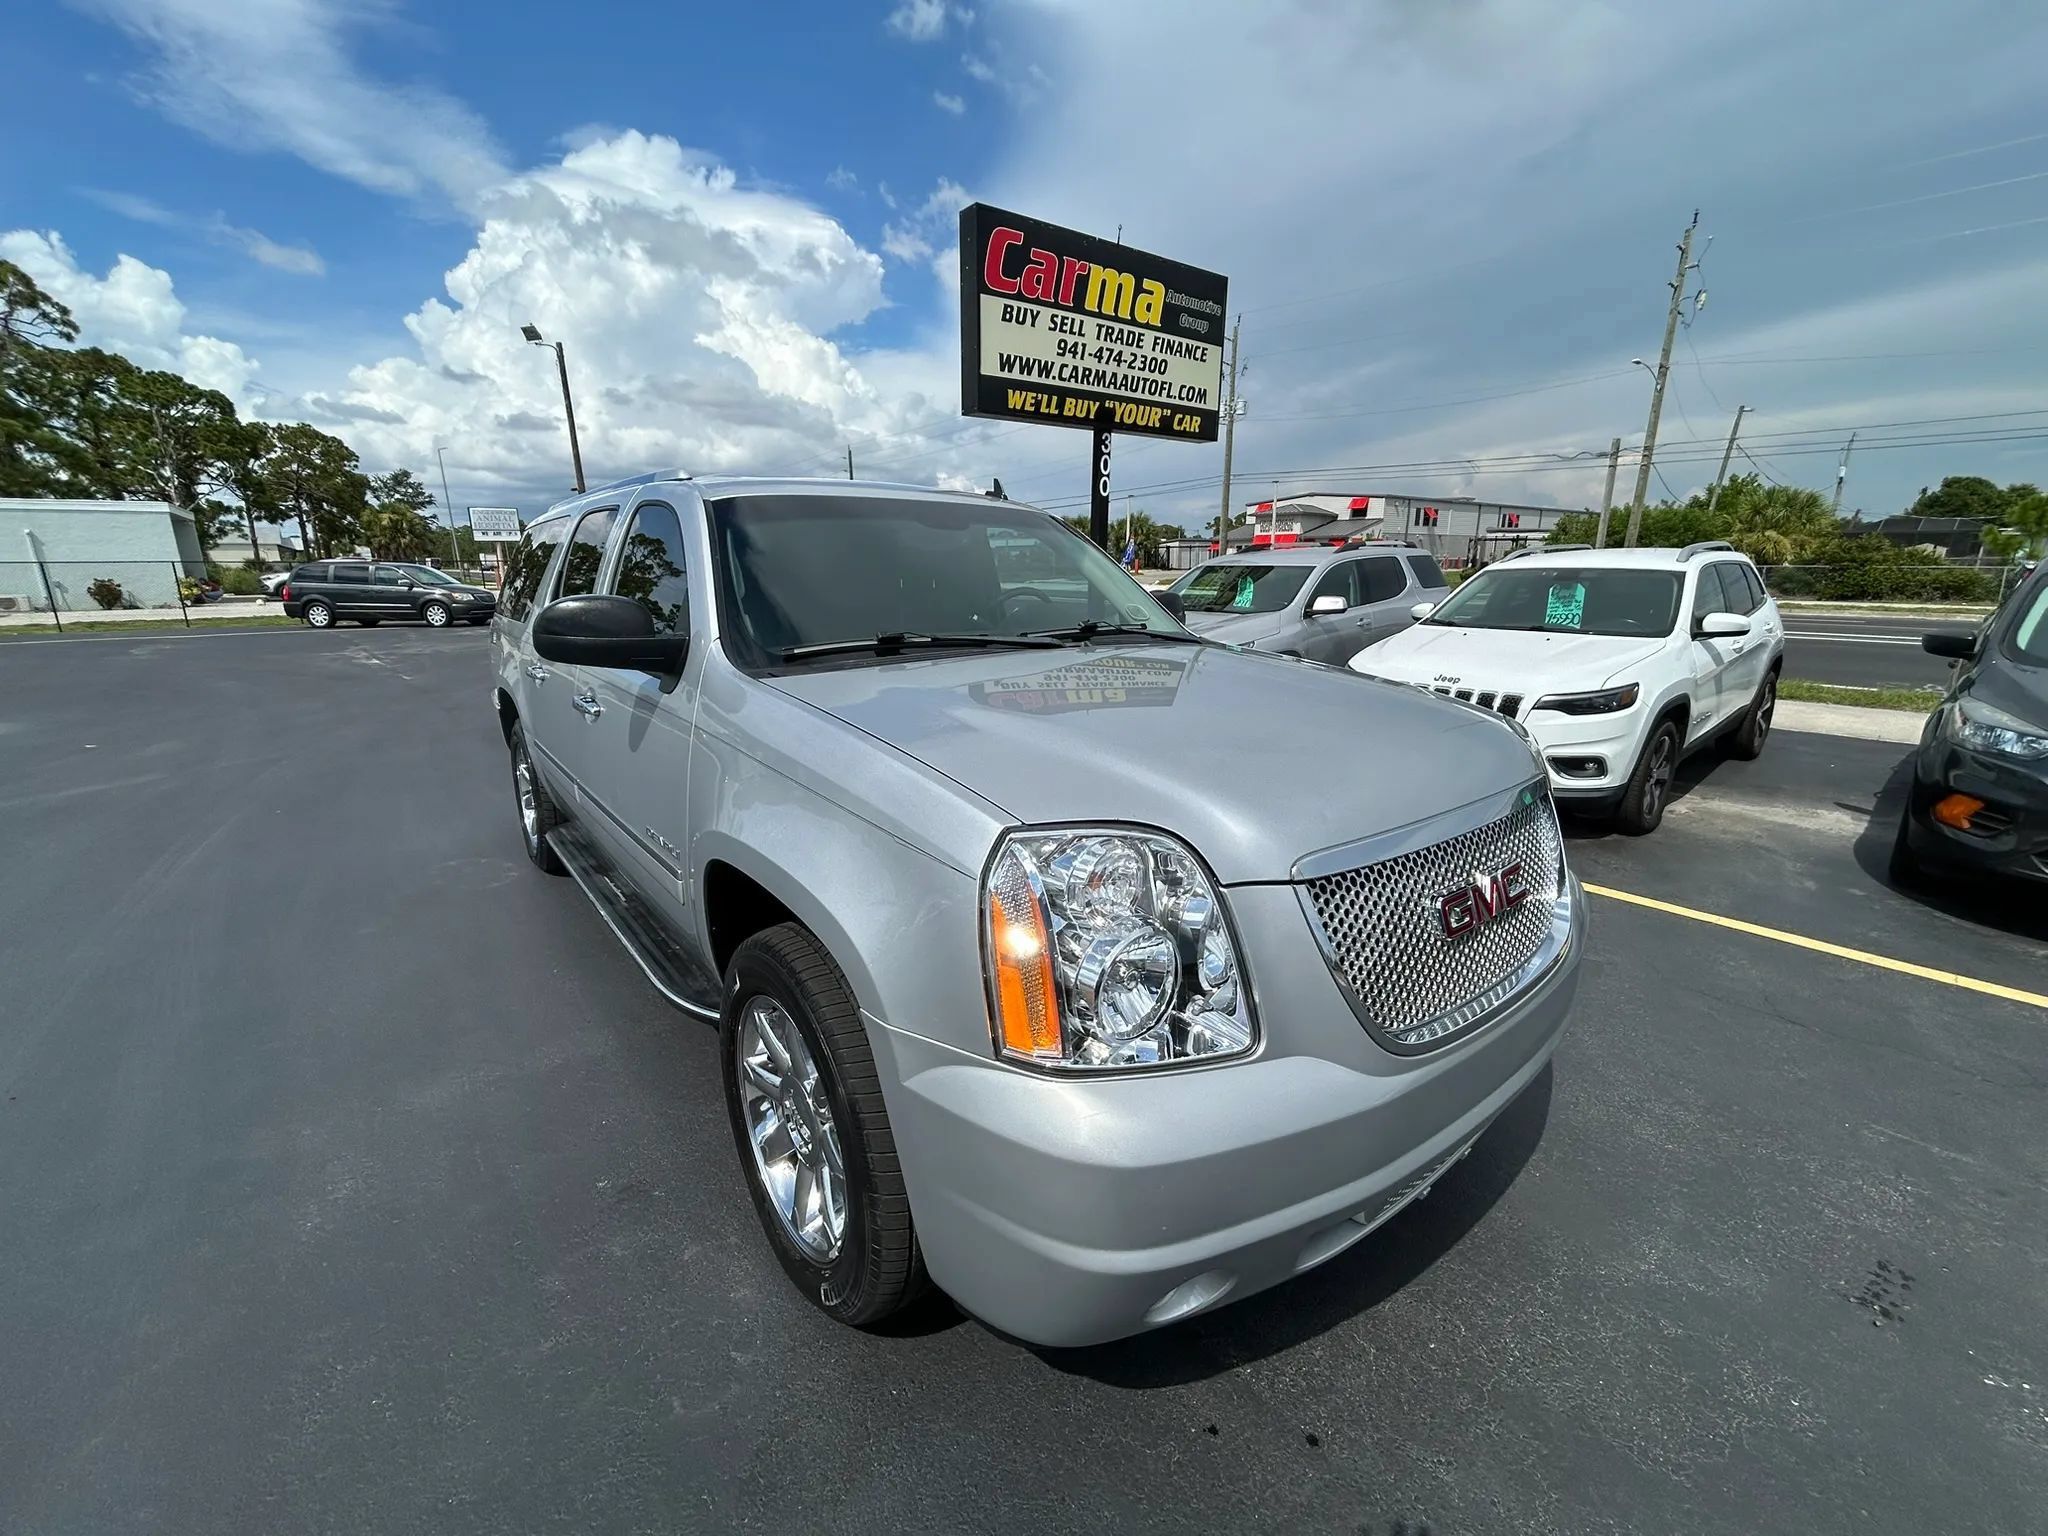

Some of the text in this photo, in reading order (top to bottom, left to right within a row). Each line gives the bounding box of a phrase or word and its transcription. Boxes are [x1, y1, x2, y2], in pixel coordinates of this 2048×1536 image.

[984, 226, 1166, 328] Carma
[1166, 289, 1222, 317] Automotive
[1179, 312, 1209, 334] Group
[1001, 303, 1208, 363] BUY SELL TRADE FINANCE
[1056, 338, 1168, 376] 941-474-2300
[998, 352, 1208, 405] WWW.CARMAAUTOFL.COM
[1007, 389, 1201, 433] WE'LL BUY "YOUR" CAR
[473, 521, 516, 529] HOSPITAL
[1433, 674, 1461, 685] Jeep
[1433, 860, 1528, 940] GMC
